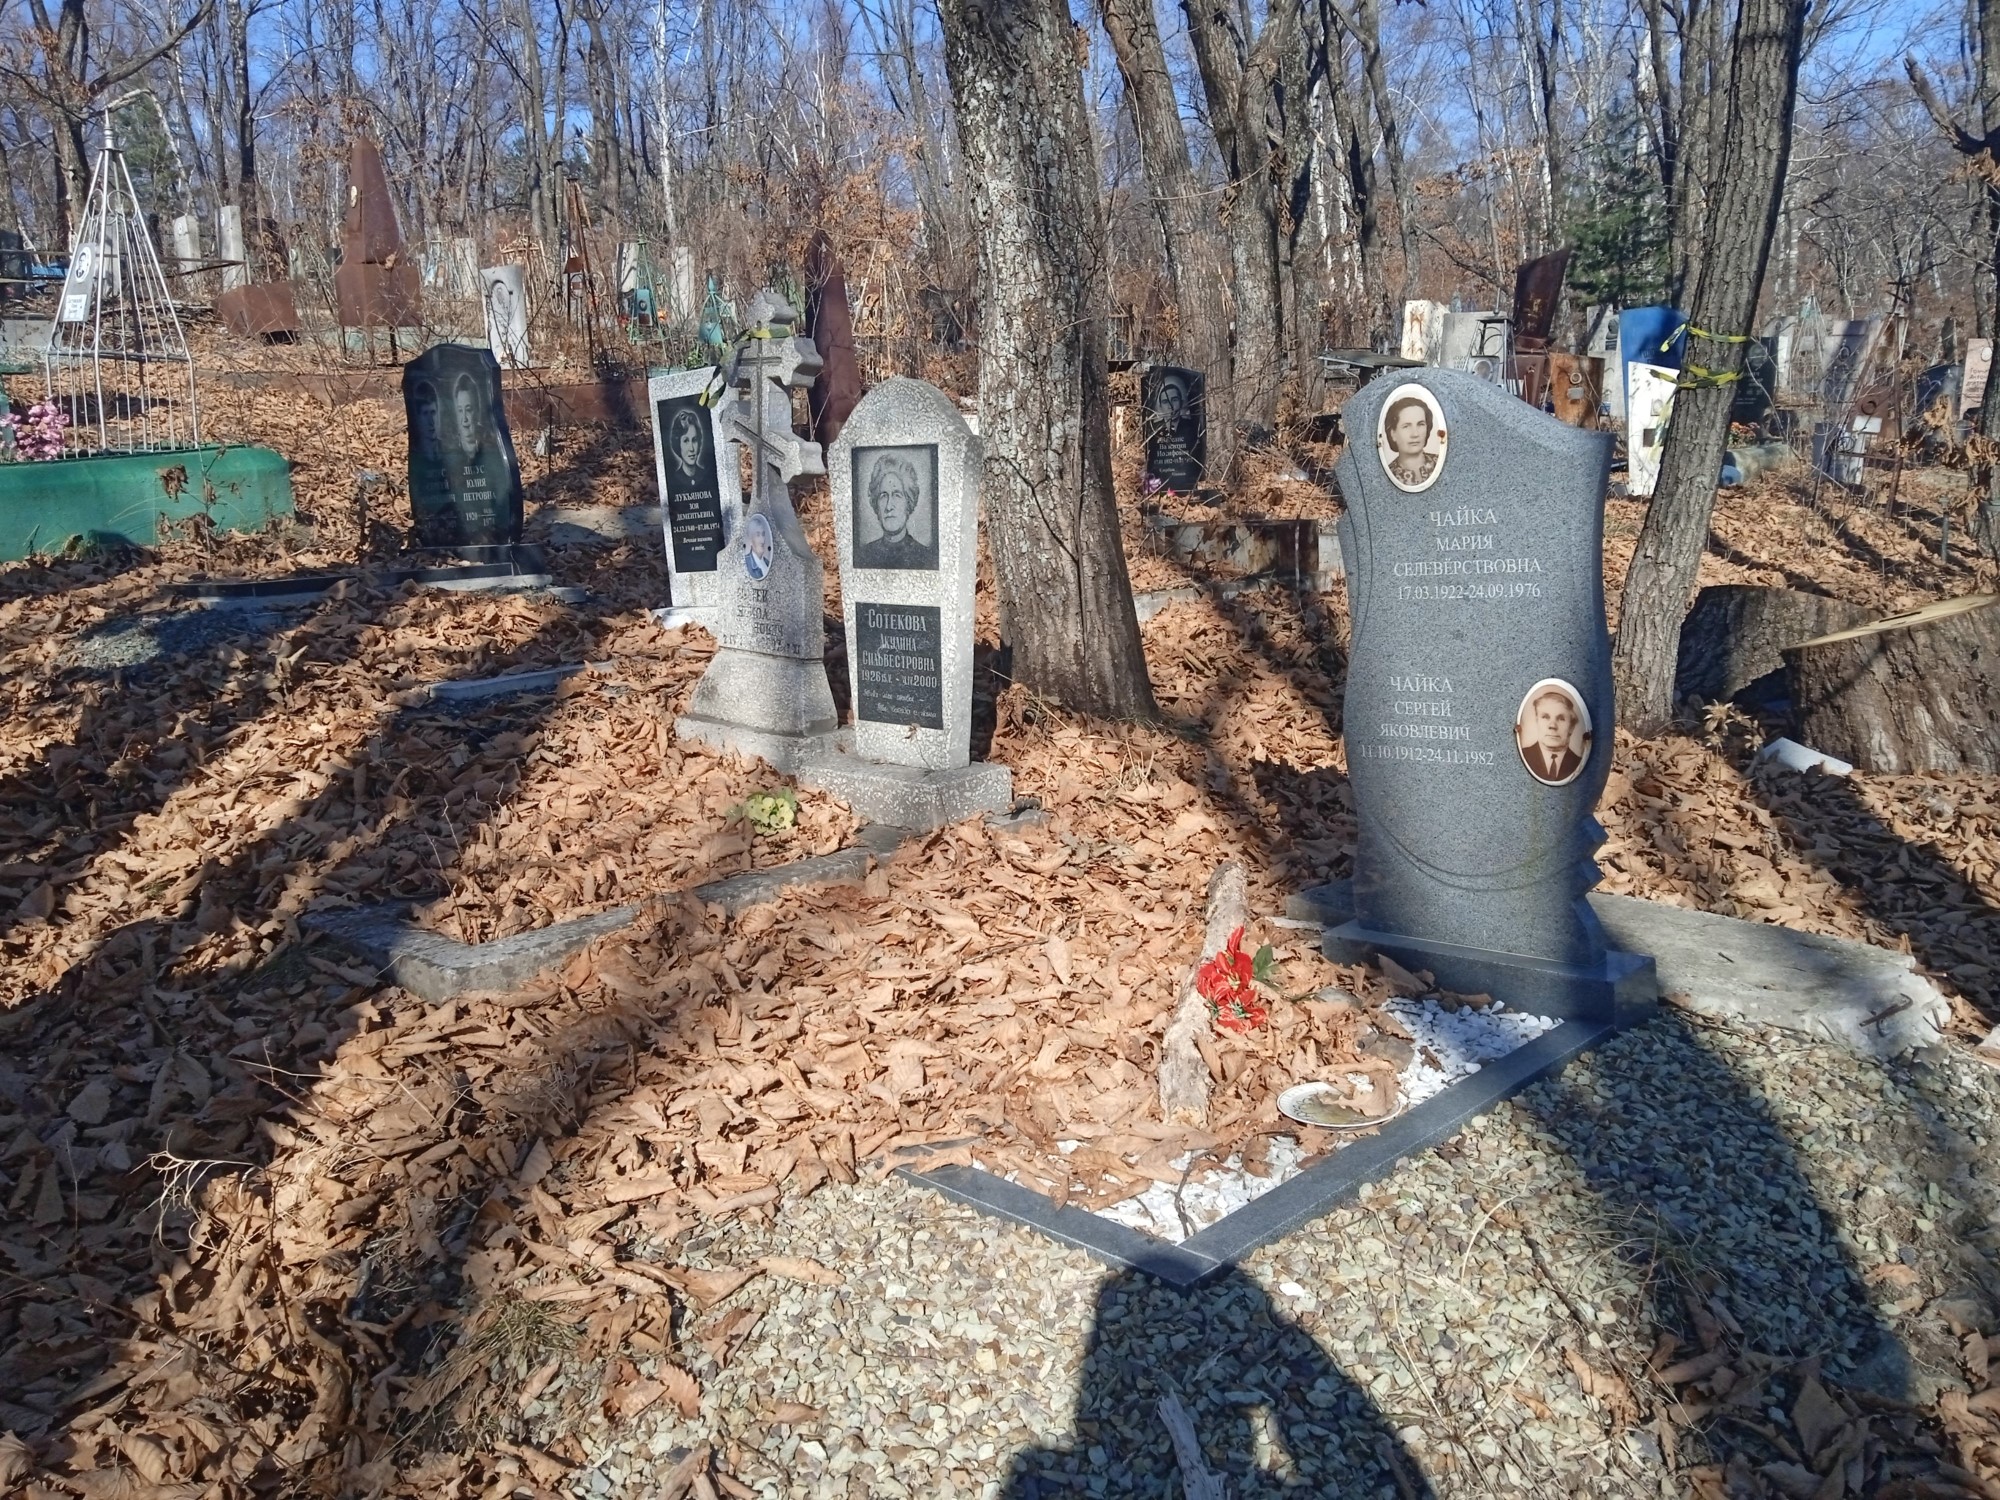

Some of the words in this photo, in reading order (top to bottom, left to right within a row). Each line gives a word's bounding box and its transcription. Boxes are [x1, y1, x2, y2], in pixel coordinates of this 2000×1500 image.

[466, 478, 487, 488] ЮЛИЯ
[689, 502, 700, 510] ЗОЯ
[1430, 505, 1498, 527] ЧАЙКА
[1436, 535, 1493, 551] МАРИЯ
[1393, 557, 1542, 577] СЕЛЕВЁРСТВОВНА
[1398, 583, 1541, 600] 17.03.1922-24.09.1976
[880, 633, 917, 652] АКУЛИНА
[862, 649, 935, 671] СИЛЬВЕСТРОВНА
[1390, 673, 1453, 693] ЧАЙКА
[1394, 699, 1452, 717] СЕРГЕЙ
[1379, 723, 1471, 741] ЯКОВЛЕВИЧ
[1361, 744, 1495, 766] 11.10.1912-24.11.1982
